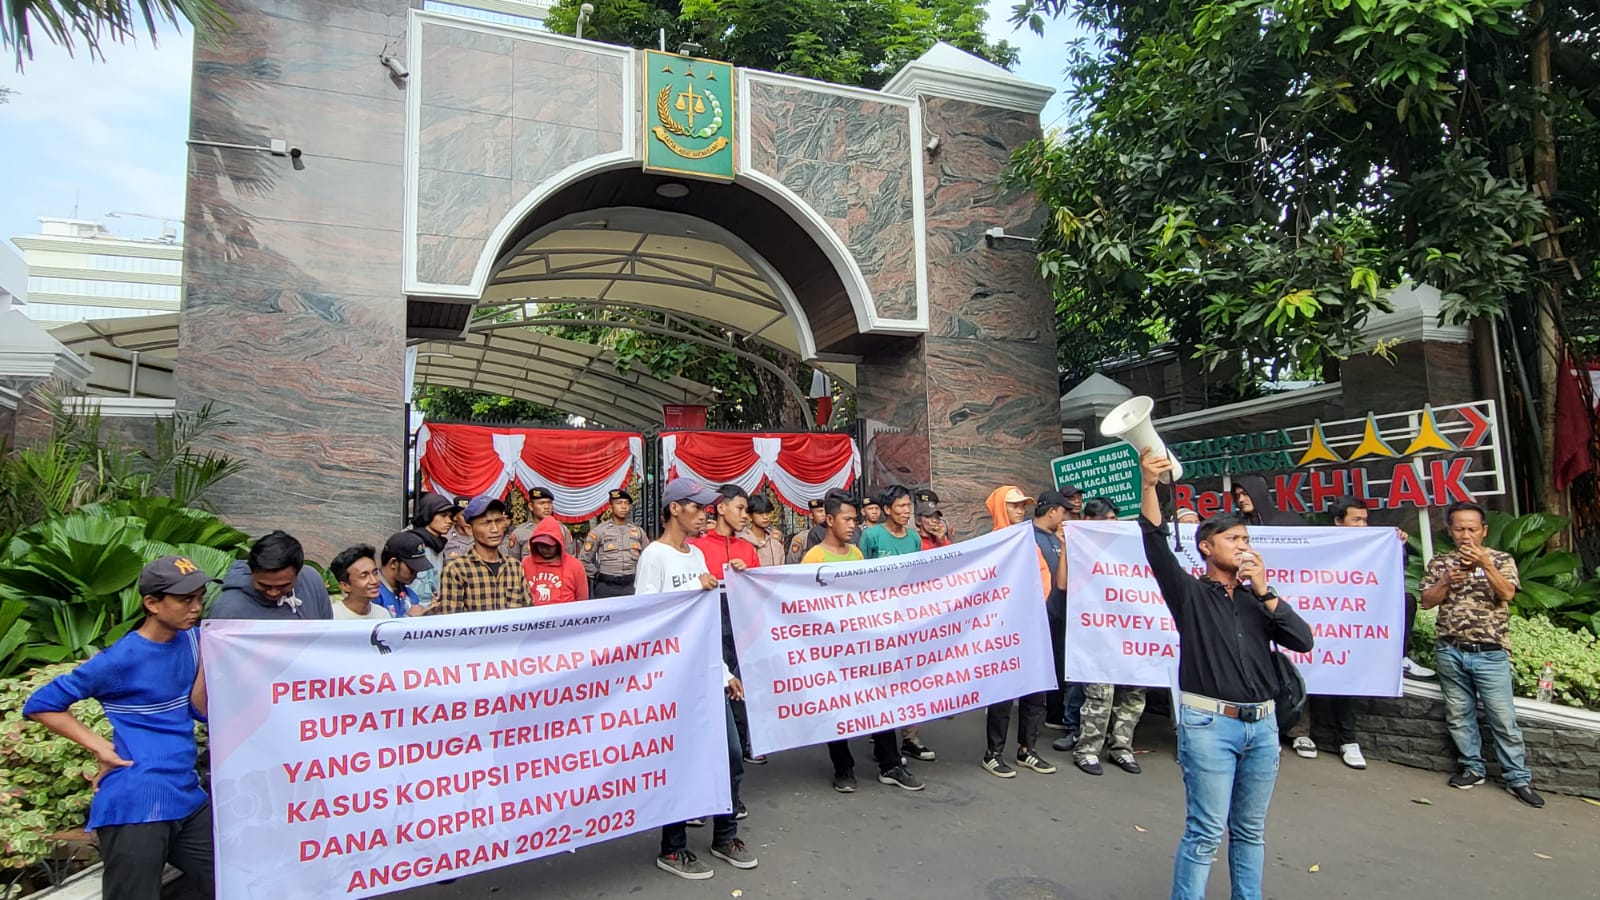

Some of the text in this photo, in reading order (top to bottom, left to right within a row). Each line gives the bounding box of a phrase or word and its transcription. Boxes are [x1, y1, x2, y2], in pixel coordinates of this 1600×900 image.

[1059, 459, 1137, 483] KACA PINTU MOBIL
[1061, 459, 1092, 472] KELUAR
[1099, 449, 1130, 463] MASUK
[1084, 477, 1107, 488] KACA
[1108, 471, 1133, 482] HELM
[1183, 451, 1294, 480] DHYAKSA
[1099, 482, 1132, 495] DIBUKA
[834, 568, 867, 579] ALIANSI
[868, 564, 899, 574] AKTIVIS
[930, 551, 963, 563] JAKARTA
[1091, 561, 1155, 578] ALIRAN
[1300, 569, 1378, 585] DIDUGA
[781, 566, 998, 614] MEMINTA KEJAGUNG UNTUK
[1298, 596, 1366, 612] BAYAR
[402, 615, 611, 640] ALIANSI AKTIVIS SUMSEL JAKARTA
[771, 587, 1010, 640] SEGERA PERIKSA DAN TANGKAP
[1080, 612, 1155, 630] SURVEY
[773, 633, 1020, 694] DIDUGA TERLIBAT DALAM KASUS
[788, 651, 805, 666] EX
[810, 641, 870, 661] BUPATI
[875, 623, 962, 651] BANYUASIN
[272, 637, 680, 704] PERIKSA DAN TANGKAP MANTAN
[778, 658, 1020, 719] DUGAAN KKN PROGRAM SERASI
[300, 708, 403, 742] BUPATI
[413, 702, 467, 725] KAB
[474, 680, 609, 717] BANYUASIN
[837, 692, 979, 735] SENILAI 335 MILIAR
[283, 702, 676, 784] YANG DIDUGA TERLIBAT DALAM
[288, 736, 674, 824] KASUS KORUPSI PENGELOLAAN
[300, 770, 666, 861] DANA KORPRI BANYUASIN TH
[348, 809, 635, 892] ANGGARAN 2022-2023
